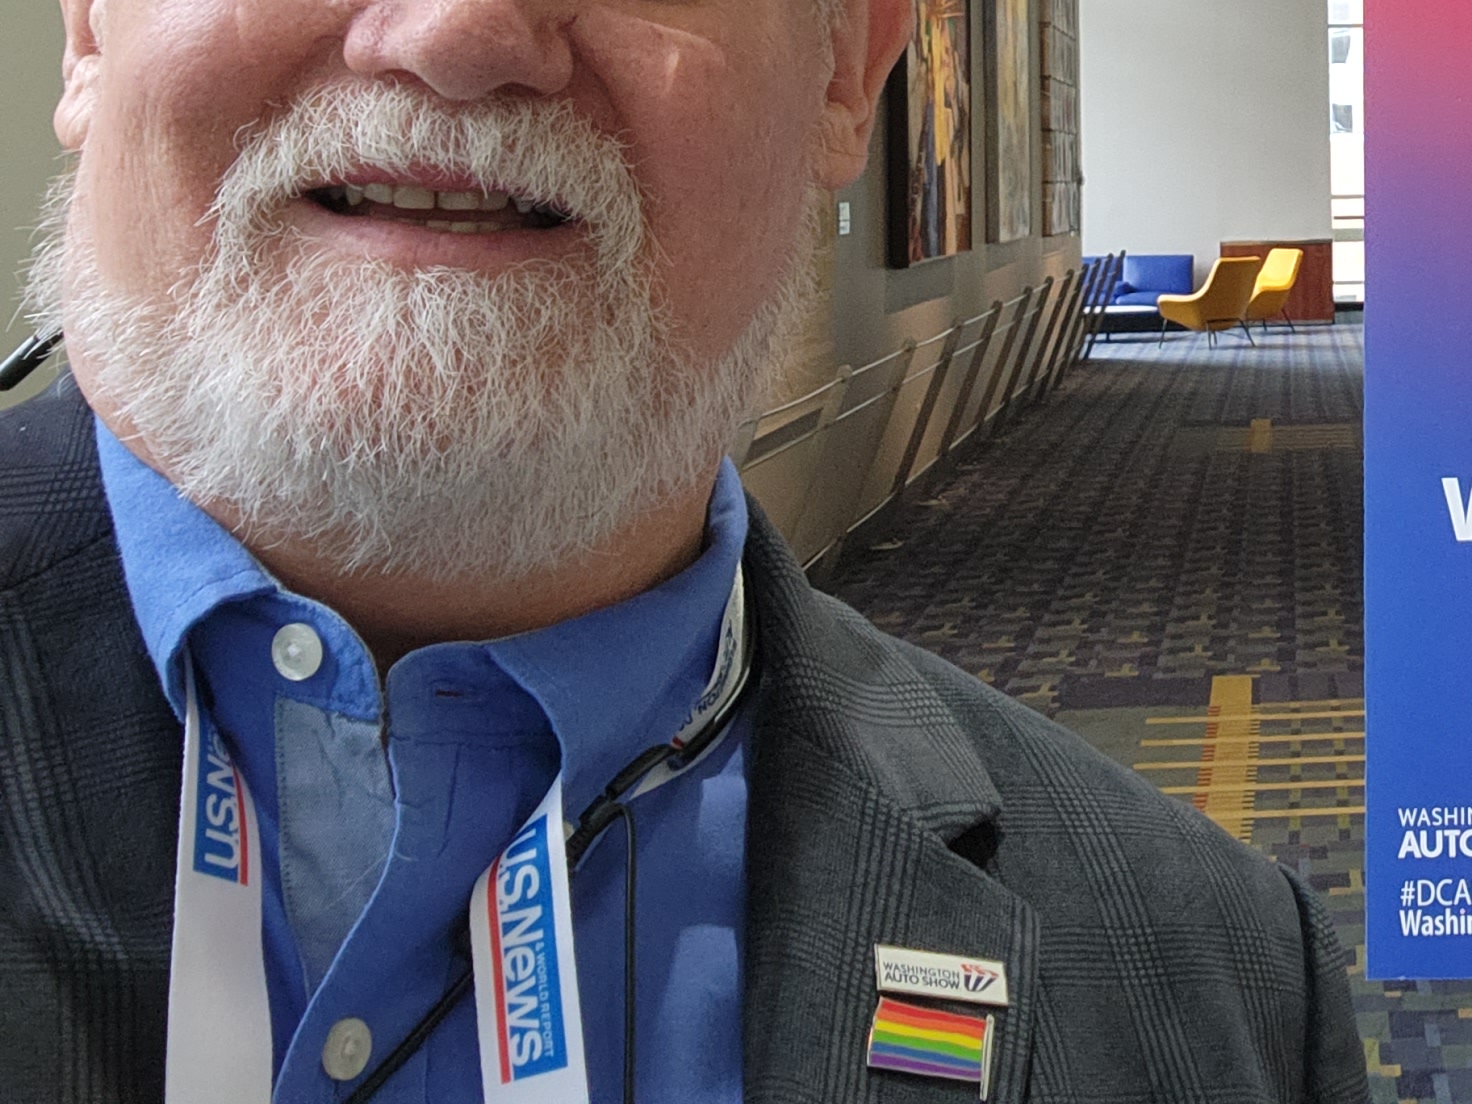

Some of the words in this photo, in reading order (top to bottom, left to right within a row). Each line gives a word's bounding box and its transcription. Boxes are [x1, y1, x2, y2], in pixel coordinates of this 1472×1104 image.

[535, 941, 545, 953] &
[536, 952, 549, 1002] WORLD
[883, 961, 960, 979] WASHINGTON
[884, 971, 920, 985] AUTO
[922, 976, 960, 990] SHOW
[541, 1002, 555, 1057] REPORT
